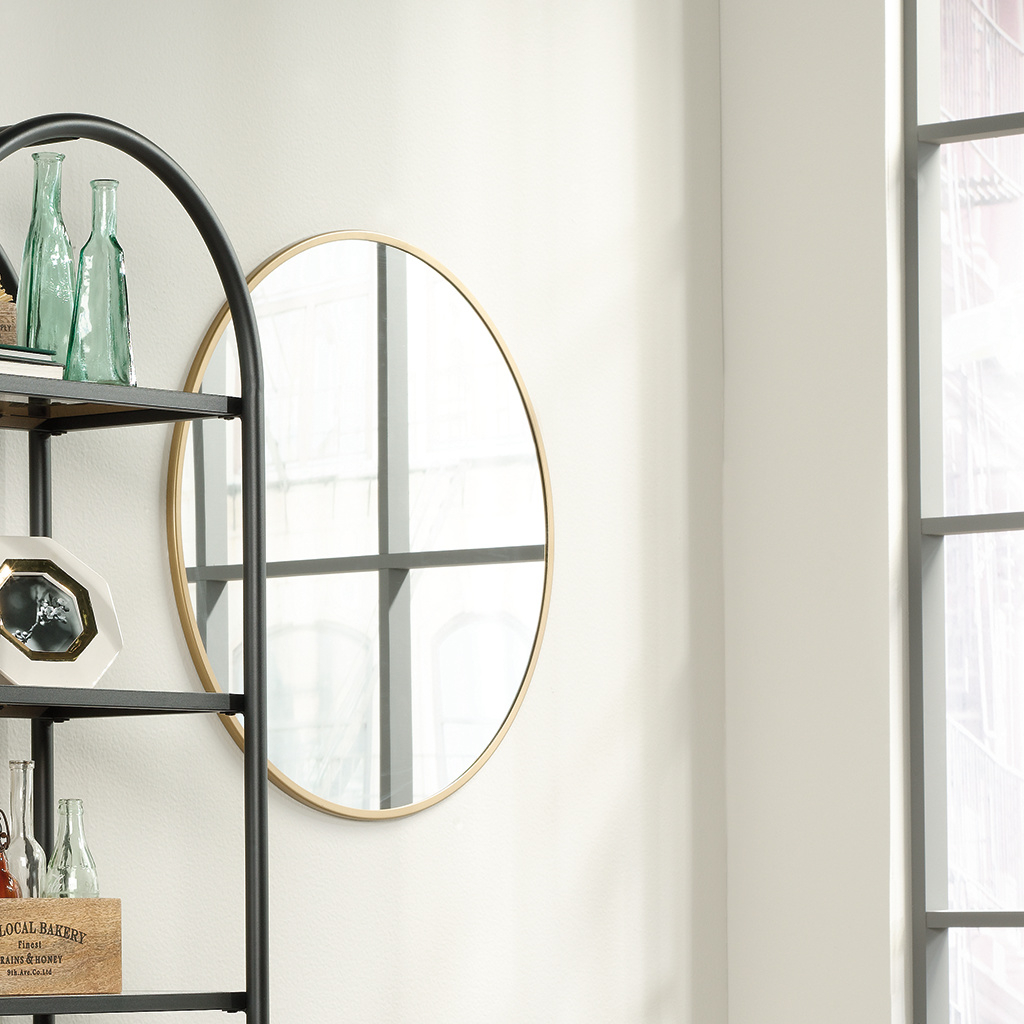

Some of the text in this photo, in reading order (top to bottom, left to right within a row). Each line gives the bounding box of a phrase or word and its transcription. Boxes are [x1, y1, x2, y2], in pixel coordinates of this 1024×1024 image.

[39, 921, 88, 945] BAKERY
[18, 940, 42, 949] Finest
[25, 952, 34, 965] &
[36, 955, 63, 964] HONEY
